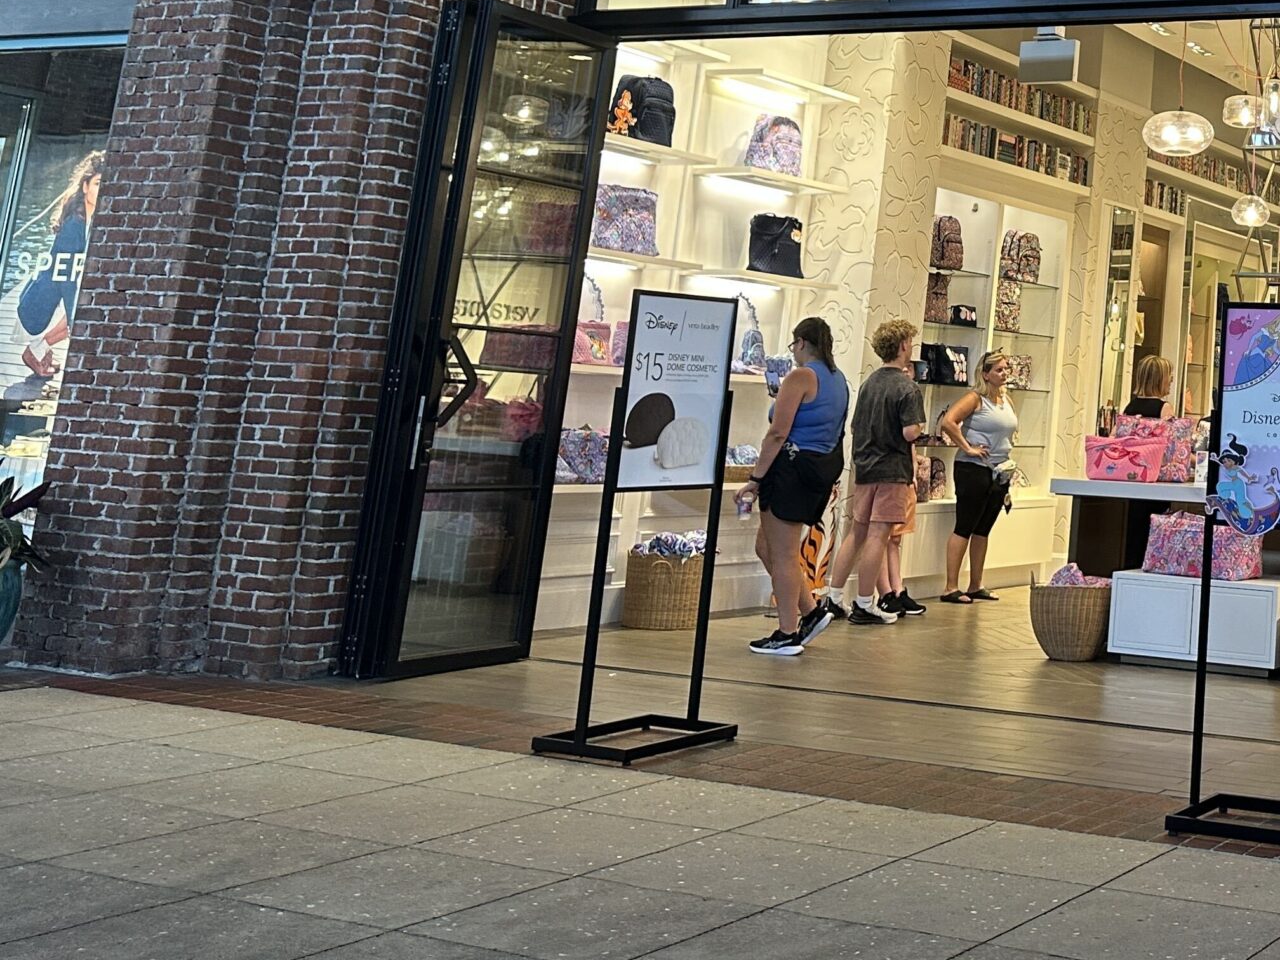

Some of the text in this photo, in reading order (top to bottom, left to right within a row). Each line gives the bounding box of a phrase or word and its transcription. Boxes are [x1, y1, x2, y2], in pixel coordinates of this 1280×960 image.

[668, 353, 704, 362] DISNEY MINI
[635, 352, 664, 381] $15
[666, 363, 718, 373] DOME COSMETIC
